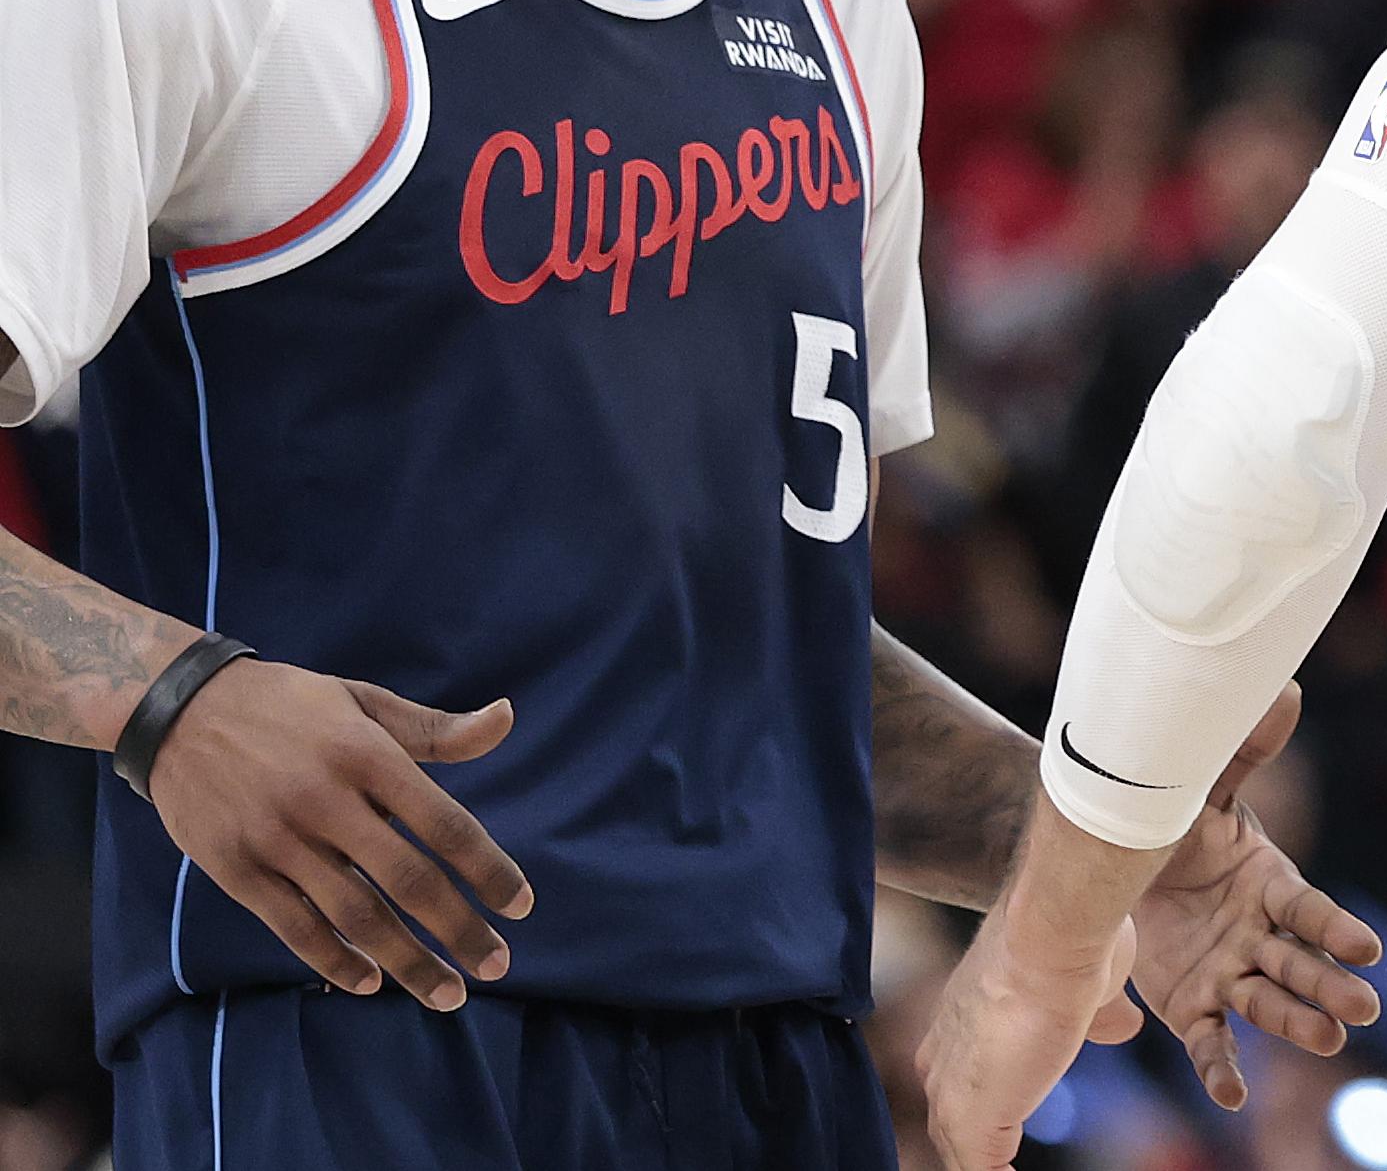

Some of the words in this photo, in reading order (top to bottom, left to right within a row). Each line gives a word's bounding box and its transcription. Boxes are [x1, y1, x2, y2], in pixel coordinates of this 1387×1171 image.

[724, 39, 827, 81] RWANDA
[736, 15, 795, 50] VISIT
[459, 106, 861, 316] Clippers
[782, 311, 868, 543] 5
